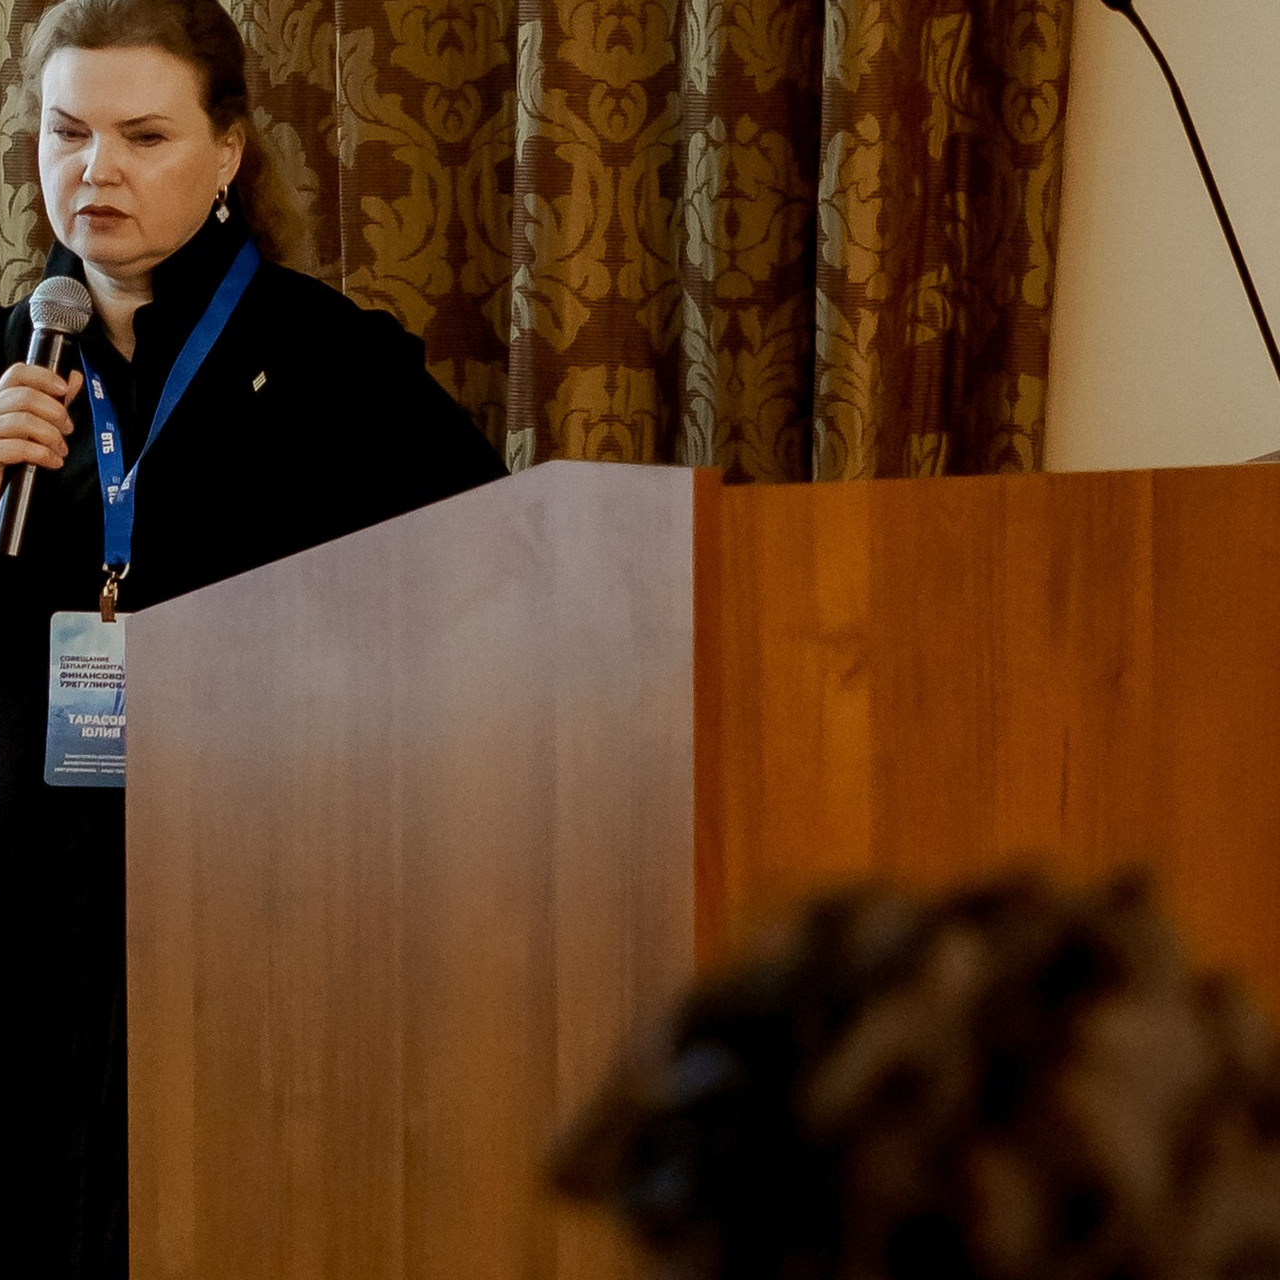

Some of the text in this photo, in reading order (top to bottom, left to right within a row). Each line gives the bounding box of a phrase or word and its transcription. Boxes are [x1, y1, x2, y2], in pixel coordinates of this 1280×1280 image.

[101, 432, 114, 454] ВТБ
[60, 655, 110, 663] СОВЕЩАНИЕ
[60, 663, 124, 671] ДЕПАРТАМЕНТА
[81, 726, 121, 738] ЮЛИЯ
